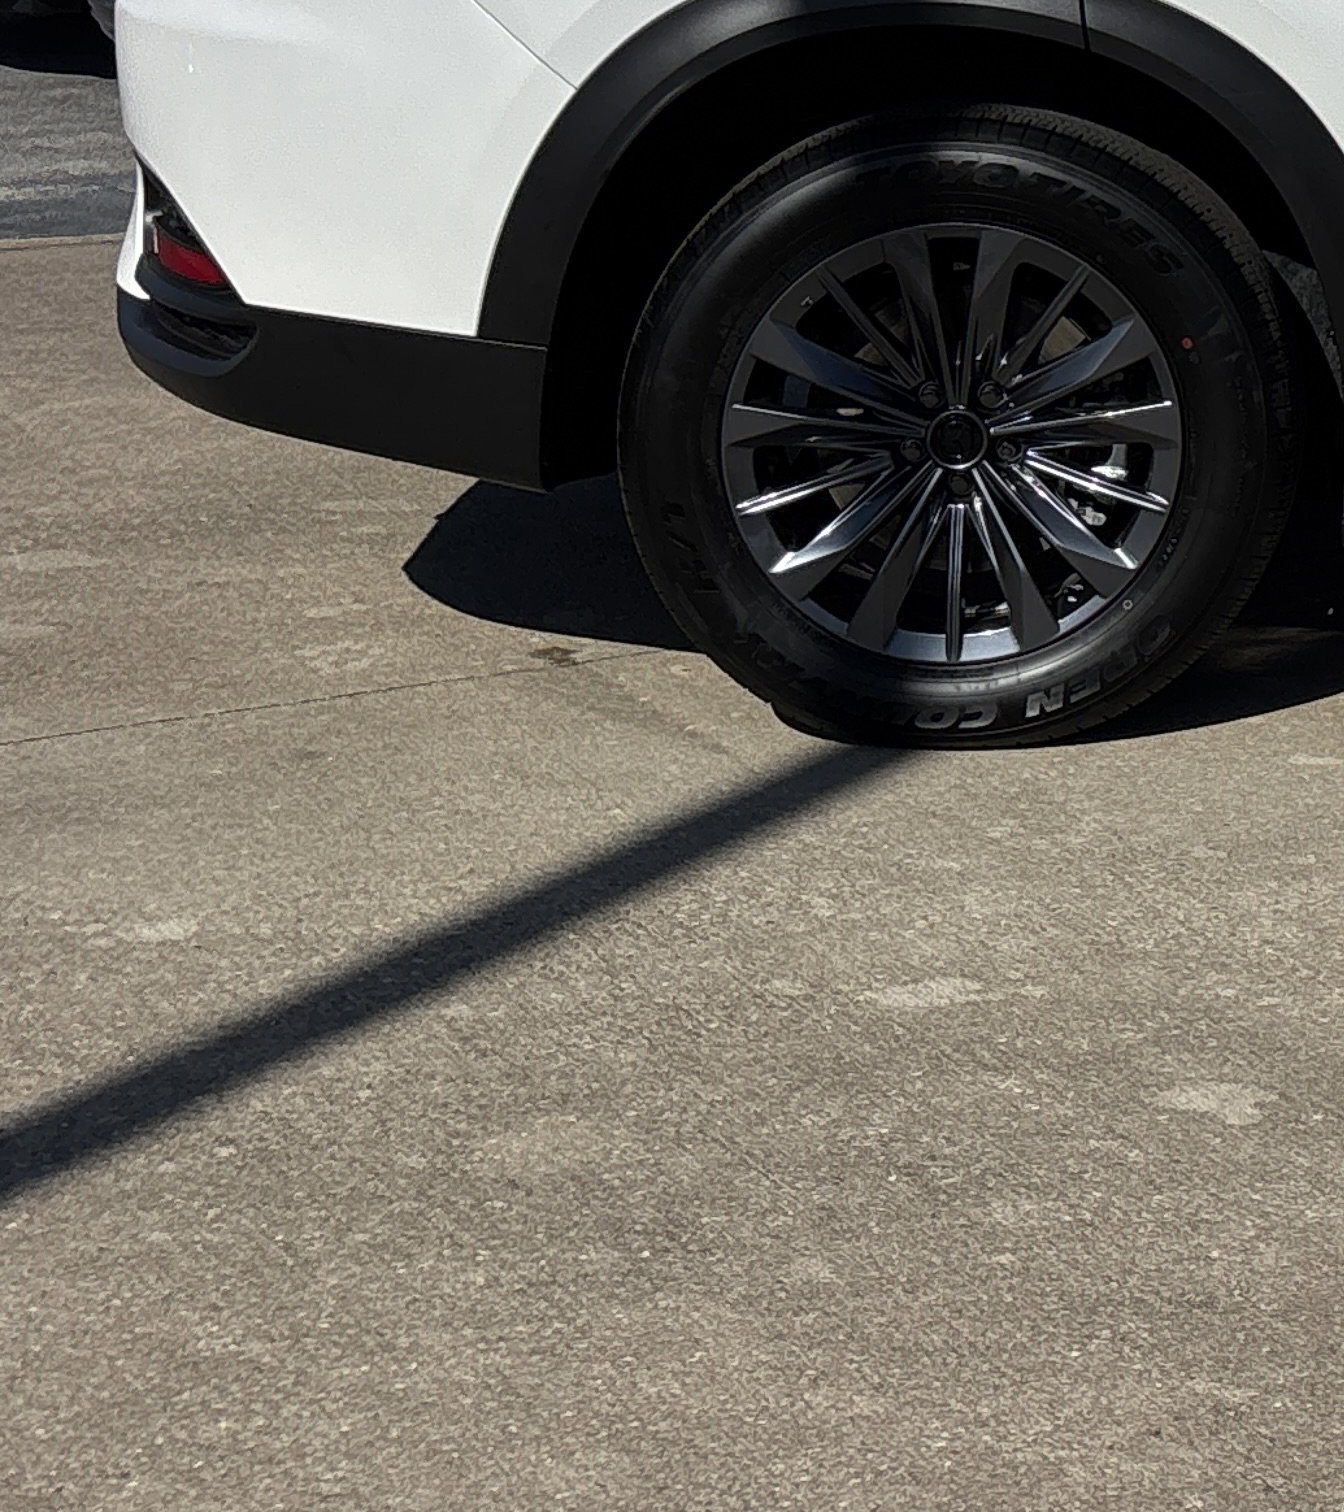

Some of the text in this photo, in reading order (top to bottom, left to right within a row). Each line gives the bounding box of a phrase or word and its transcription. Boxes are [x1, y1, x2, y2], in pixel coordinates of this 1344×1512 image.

[855, 159, 1020, 190] TOYO
[1030, 171, 1186, 276] TIRES
[1023, 614, 1174, 719] OPEN
